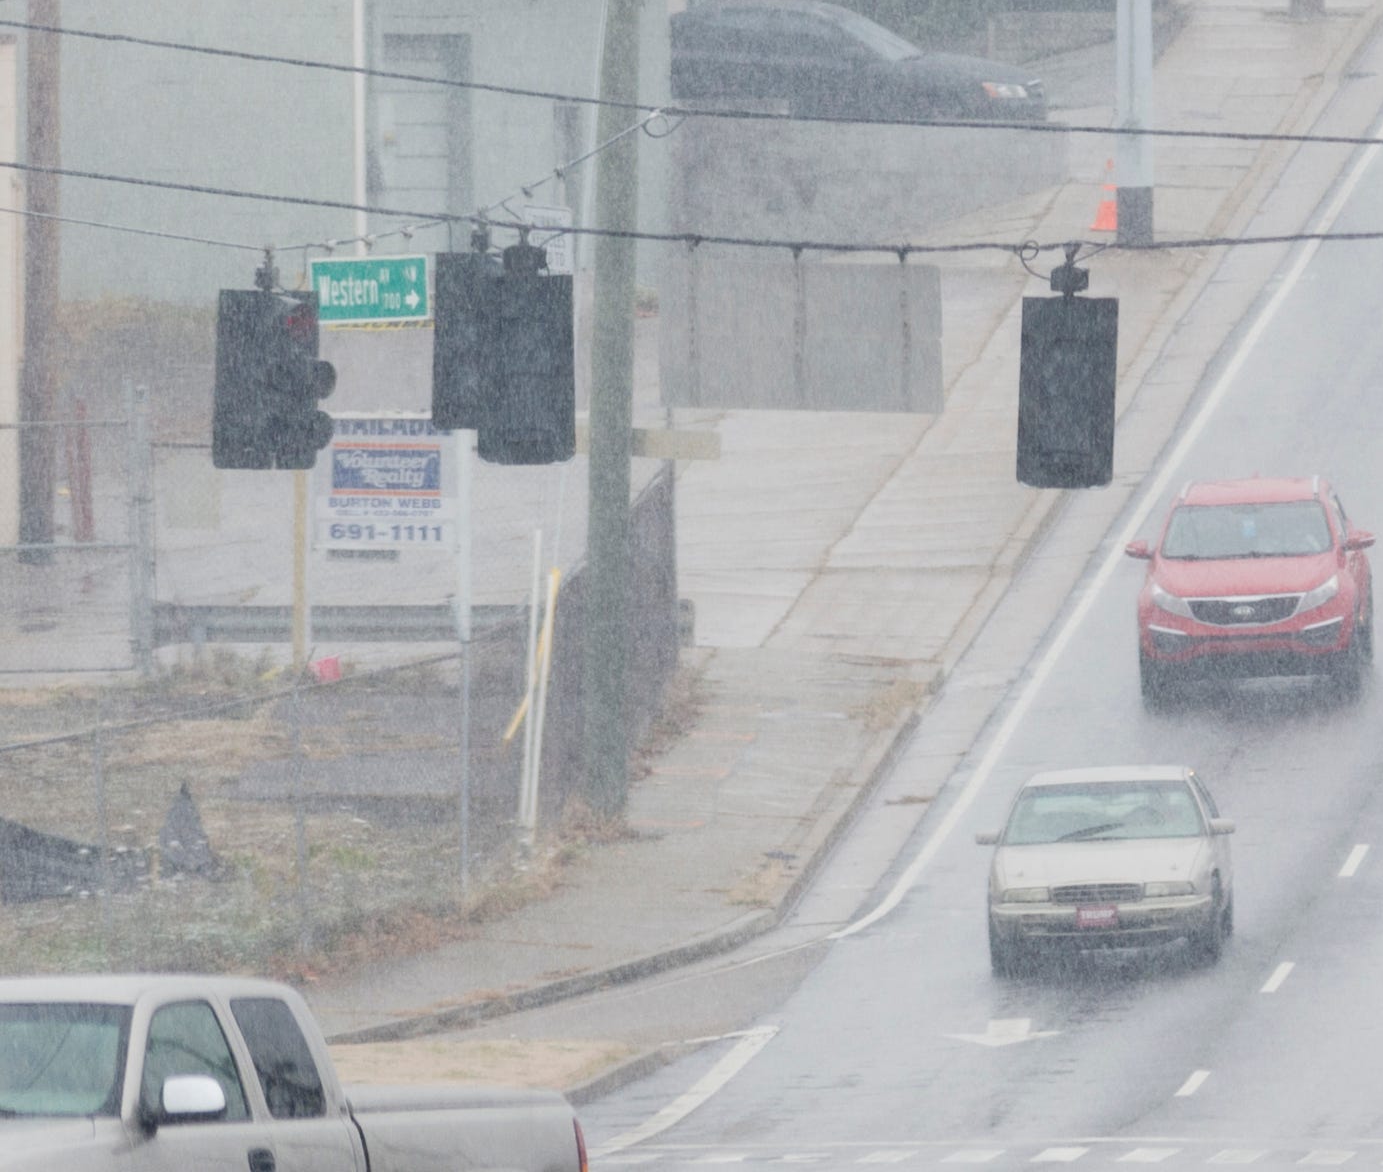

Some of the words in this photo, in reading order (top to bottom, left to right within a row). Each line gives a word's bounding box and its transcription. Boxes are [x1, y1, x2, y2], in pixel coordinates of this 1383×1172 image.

[317, 274, 379, 307] Western
[336, 450, 438, 470] Volunteer
[361, 468, 426, 488] Realty
[329, 497, 393, 509] BURTON
[397, 497, 442, 509] WEBB
[329, 522, 443, 542] 691-1111
